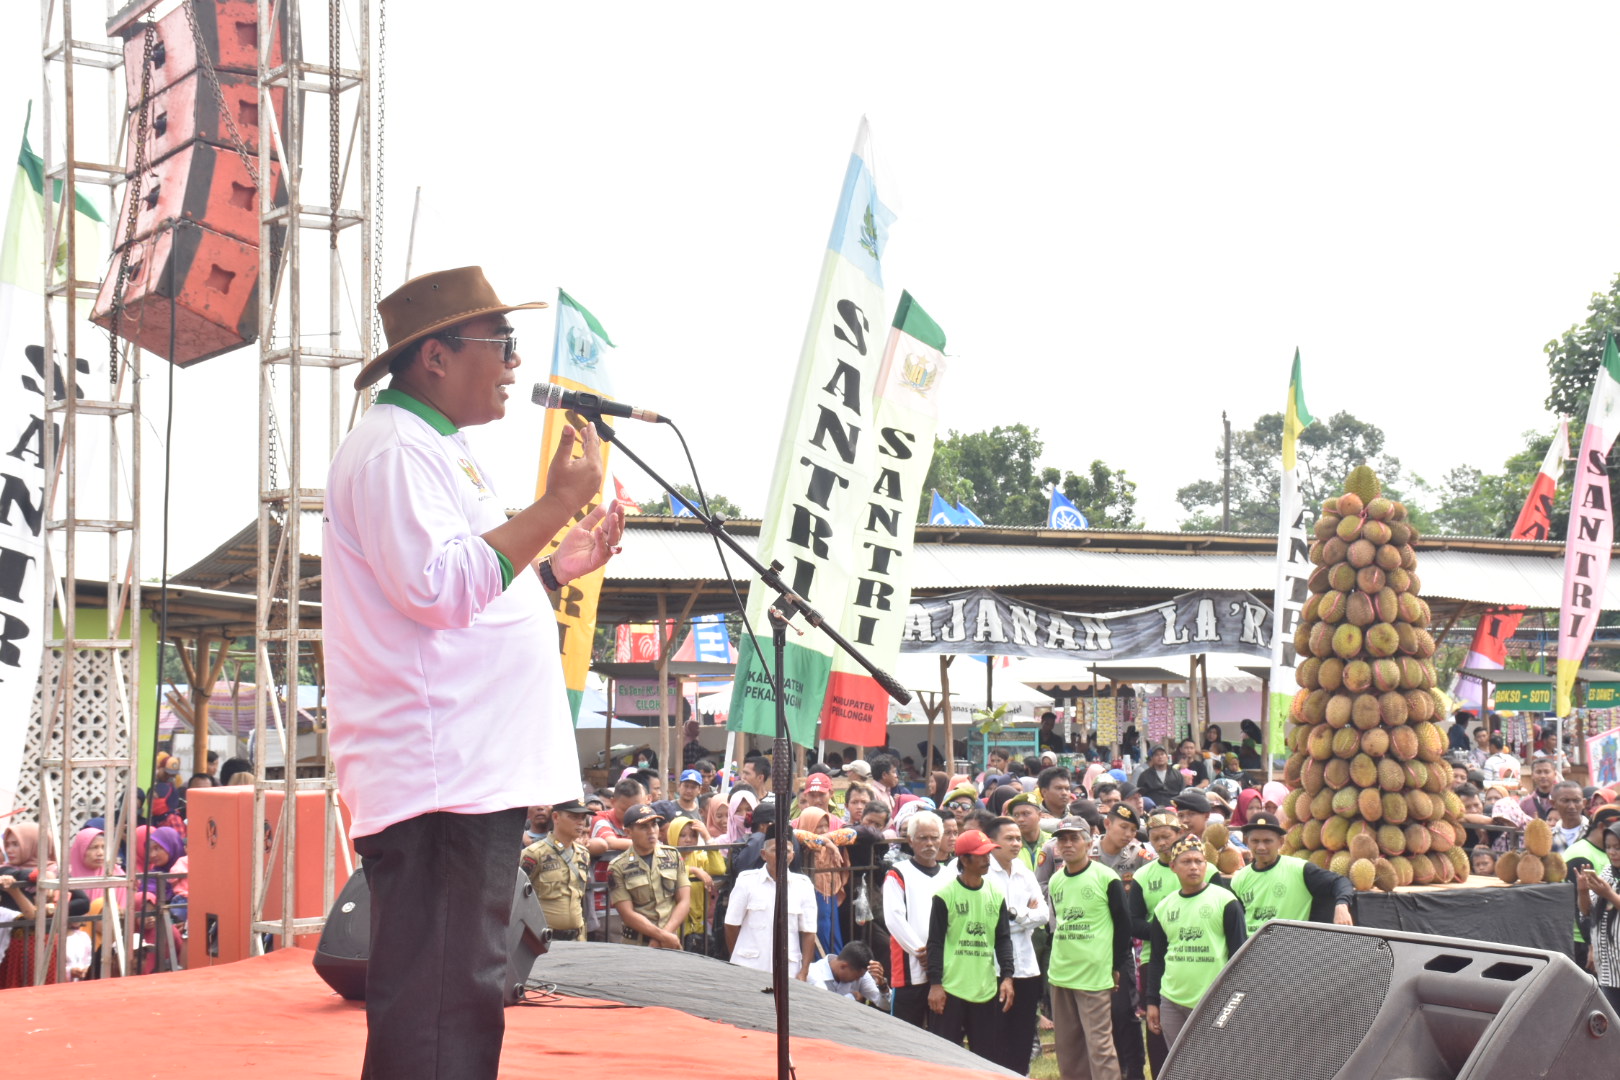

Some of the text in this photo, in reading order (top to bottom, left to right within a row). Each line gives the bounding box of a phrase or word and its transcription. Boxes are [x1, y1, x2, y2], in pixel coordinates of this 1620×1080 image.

[786, 298, 870, 603] SANTRI
[0, 344, 90, 682] SANTR
[852, 426, 916, 647] SANTRI
[1567, 449, 1608, 638] SANTRI
[904, 597, 1273, 651] AJANAN LA'R
[744, 685, 802, 710] PEKALNGAN
[747, 670, 804, 693] KABATEN
[1495, 690, 1521, 703] BAKSO
[1530, 689, 1550, 703] SOTO
[1216, 993, 1245, 1027] Hüper
